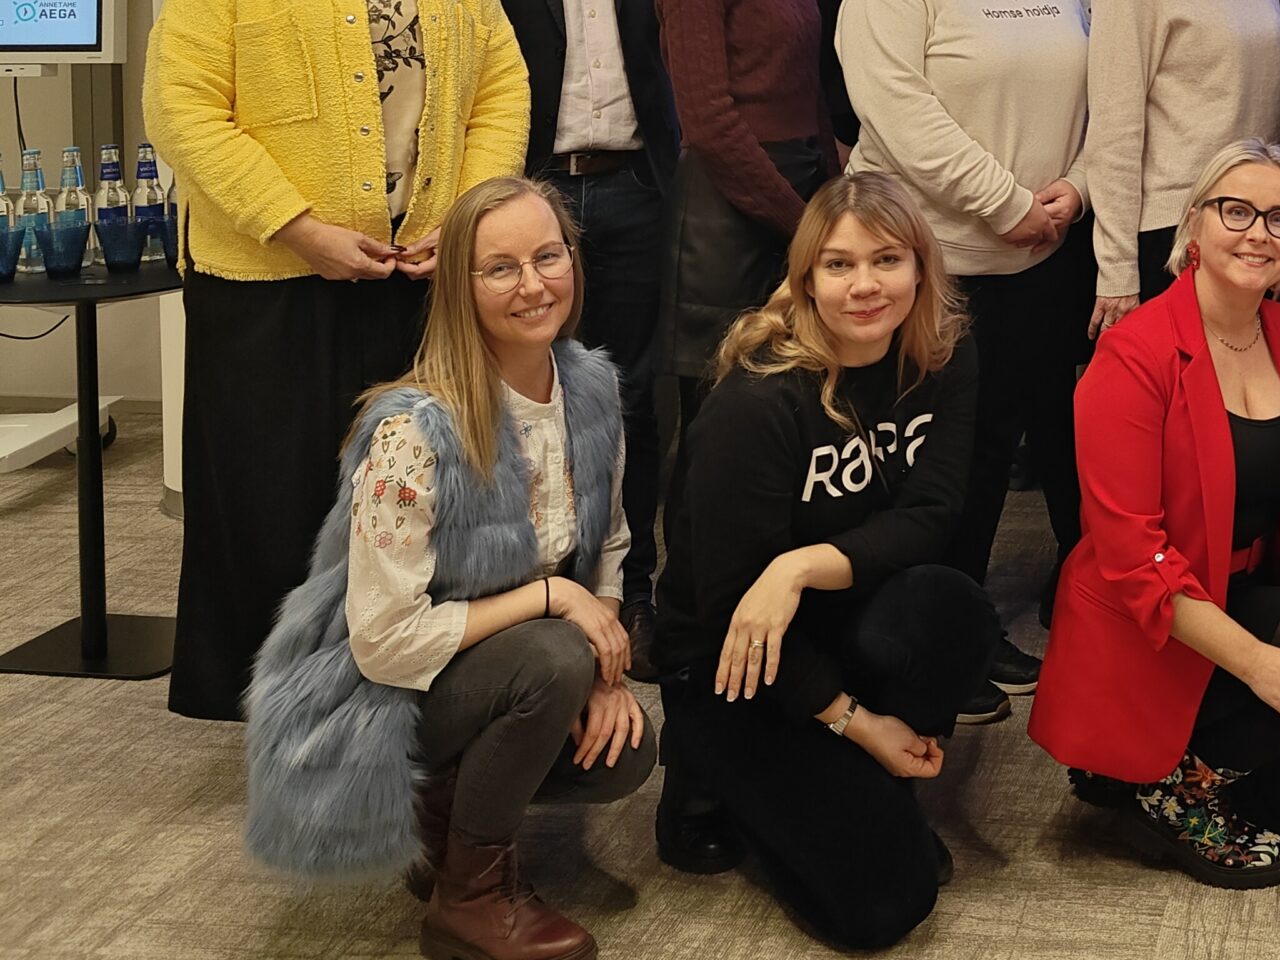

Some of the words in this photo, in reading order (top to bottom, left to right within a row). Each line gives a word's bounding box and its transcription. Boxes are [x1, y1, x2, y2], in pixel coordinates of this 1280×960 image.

[39, 9, 77, 19] AEGA
[982, 8, 1024, 19] Homse
[1023, 4, 1061, 18] hoidja
